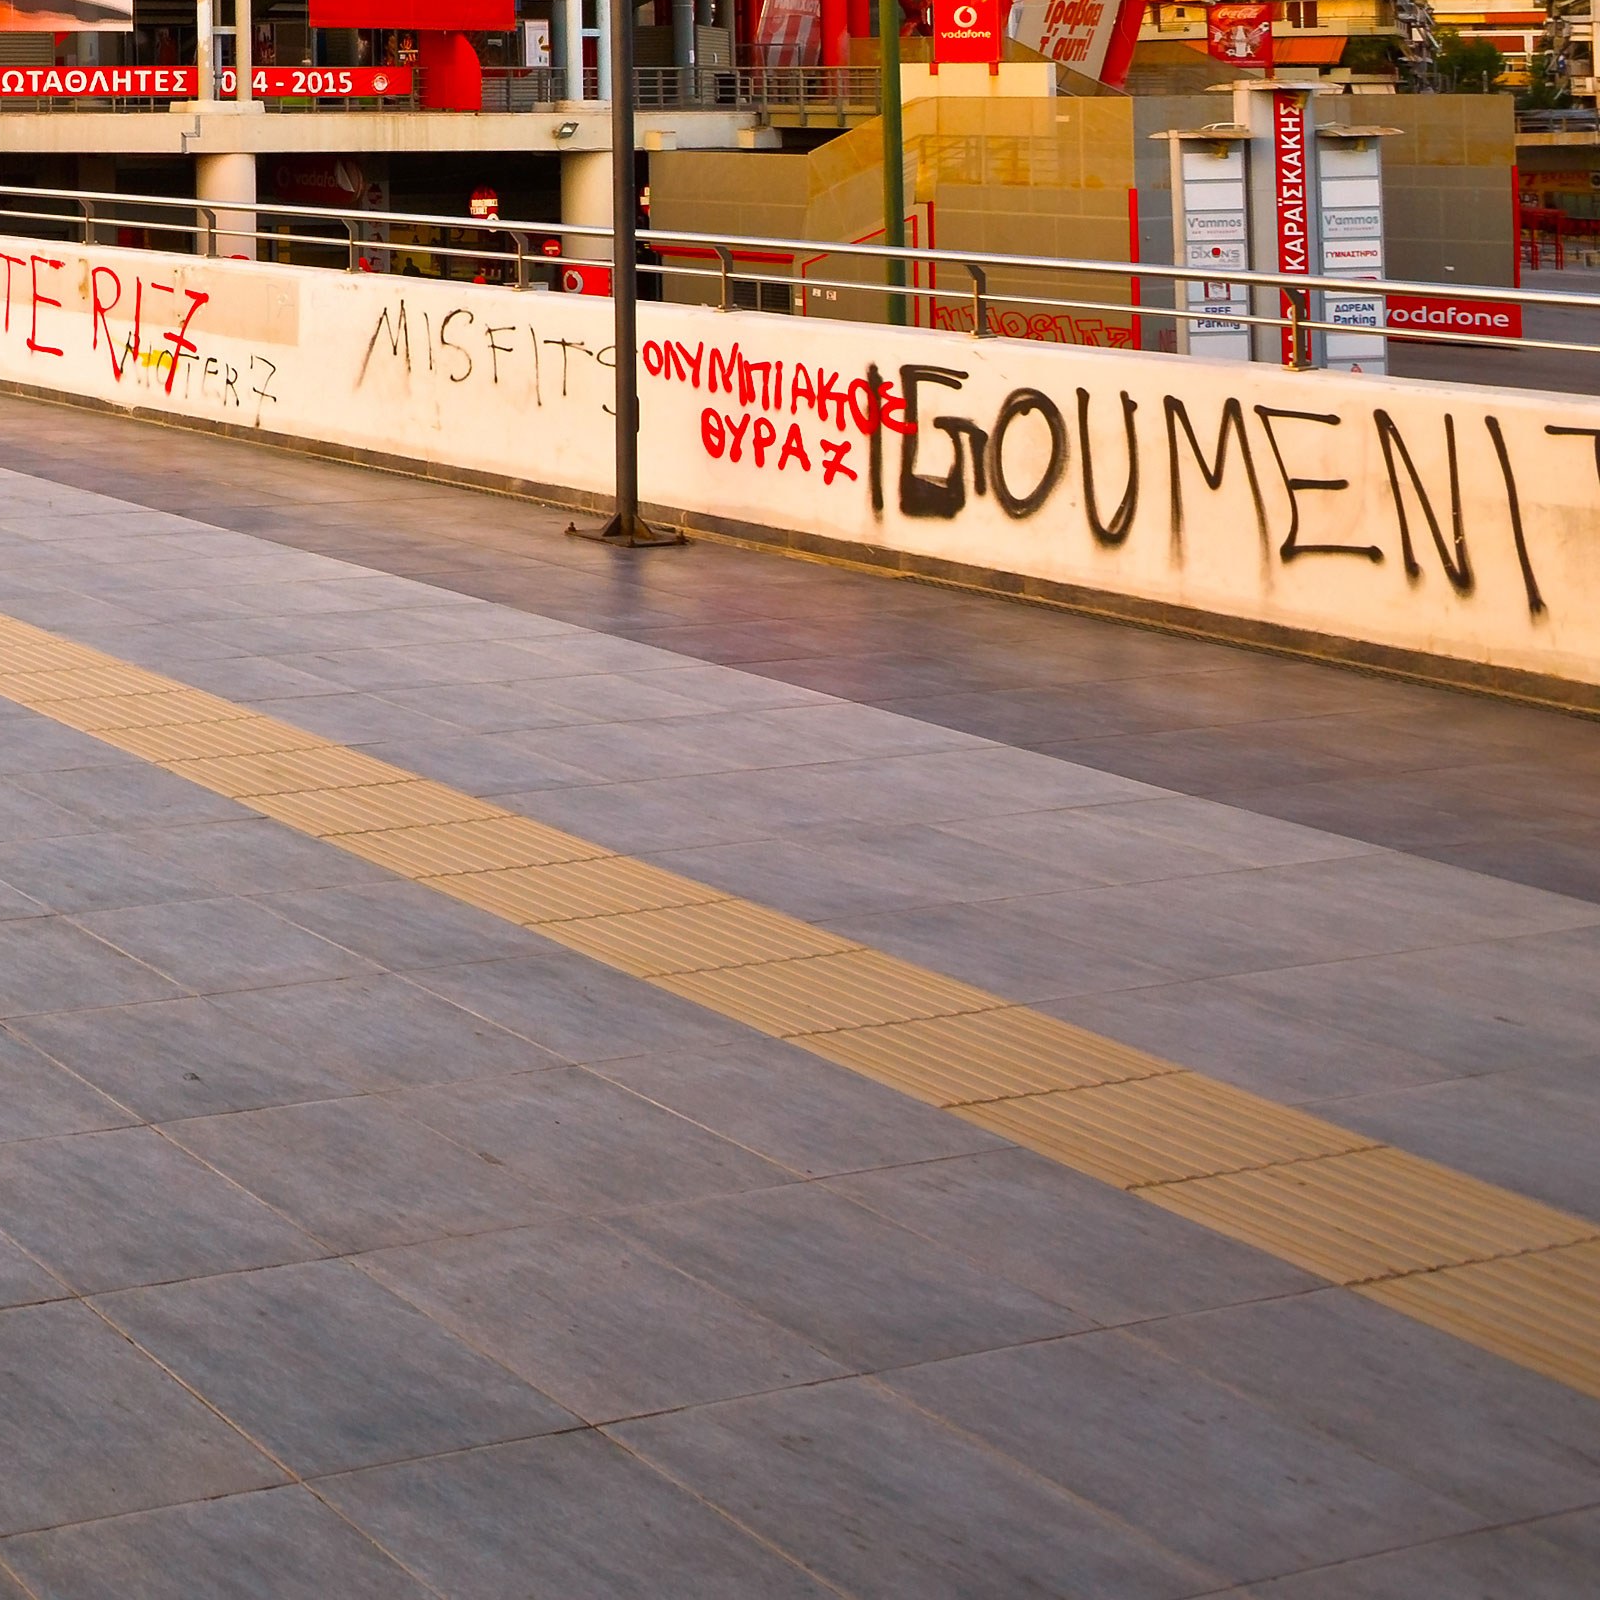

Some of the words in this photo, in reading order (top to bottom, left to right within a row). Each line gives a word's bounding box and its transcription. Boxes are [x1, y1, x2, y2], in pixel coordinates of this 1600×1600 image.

[941, 30, 991, 38] vodafone
[292, 71, 353, 93] 2015
[1326, 250, 1378, 258] ΓΥΜΝΑΣΤΗΡΙΟ
[1335, 303, 1375, 312] ΔΩΡΕΑΝ
[1333, 315, 1377, 326] Parking
[701, 407, 813, 472] ΘΥΡΑ
[820, 437, 858, 485] 7
